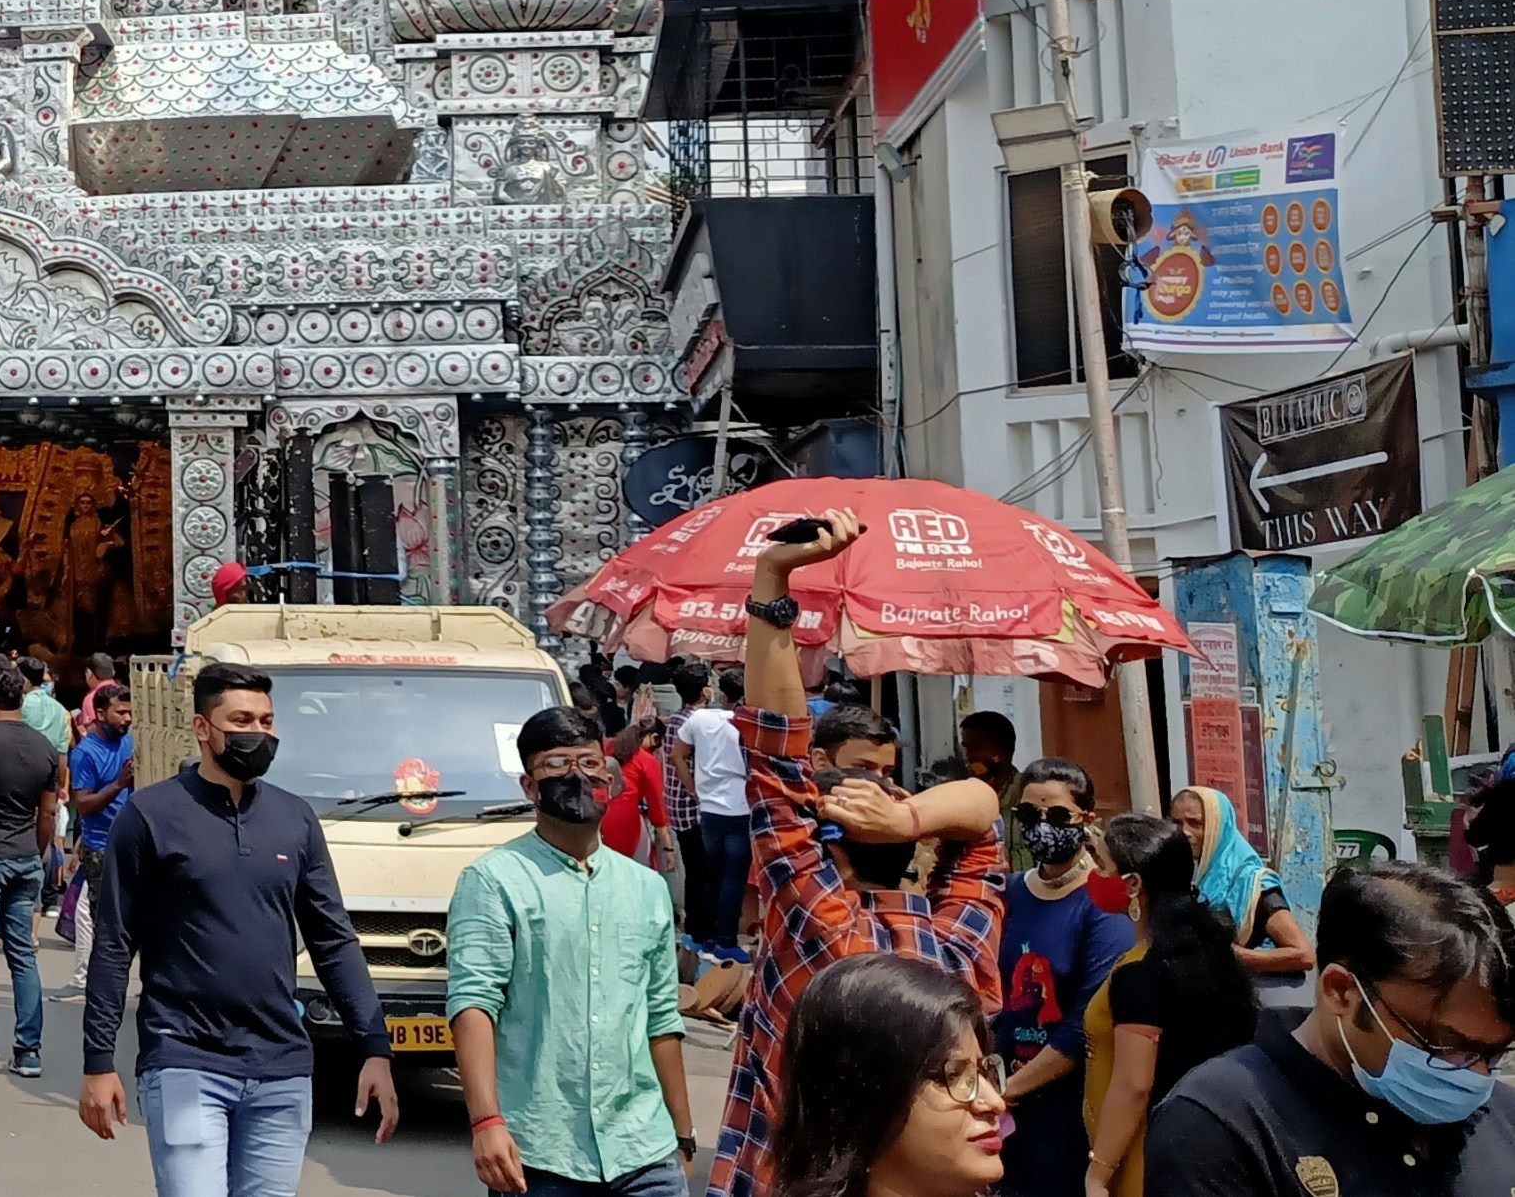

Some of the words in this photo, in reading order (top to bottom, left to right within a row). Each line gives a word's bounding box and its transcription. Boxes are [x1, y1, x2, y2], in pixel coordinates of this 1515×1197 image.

[1229, 147, 1257, 158] Union
[1259, 141, 1285, 154] Bank
[892, 514, 967, 543] RED
[1260, 511, 1317, 550] THIS
[1325, 497, 1386, 536] WAY
[895, 542, 925, 555] FM
[896, 557, 943, 570] Bajaate
[946, 556, 983, 569] Raho!
[679, 601, 739, 621] 93.5
[881, 602, 962, 626] Bajaate
[969, 602, 1029, 623] Raho!
[382, 655, 459, 665] CARRIAGE
[413, 1024, 446, 1044] 19E
